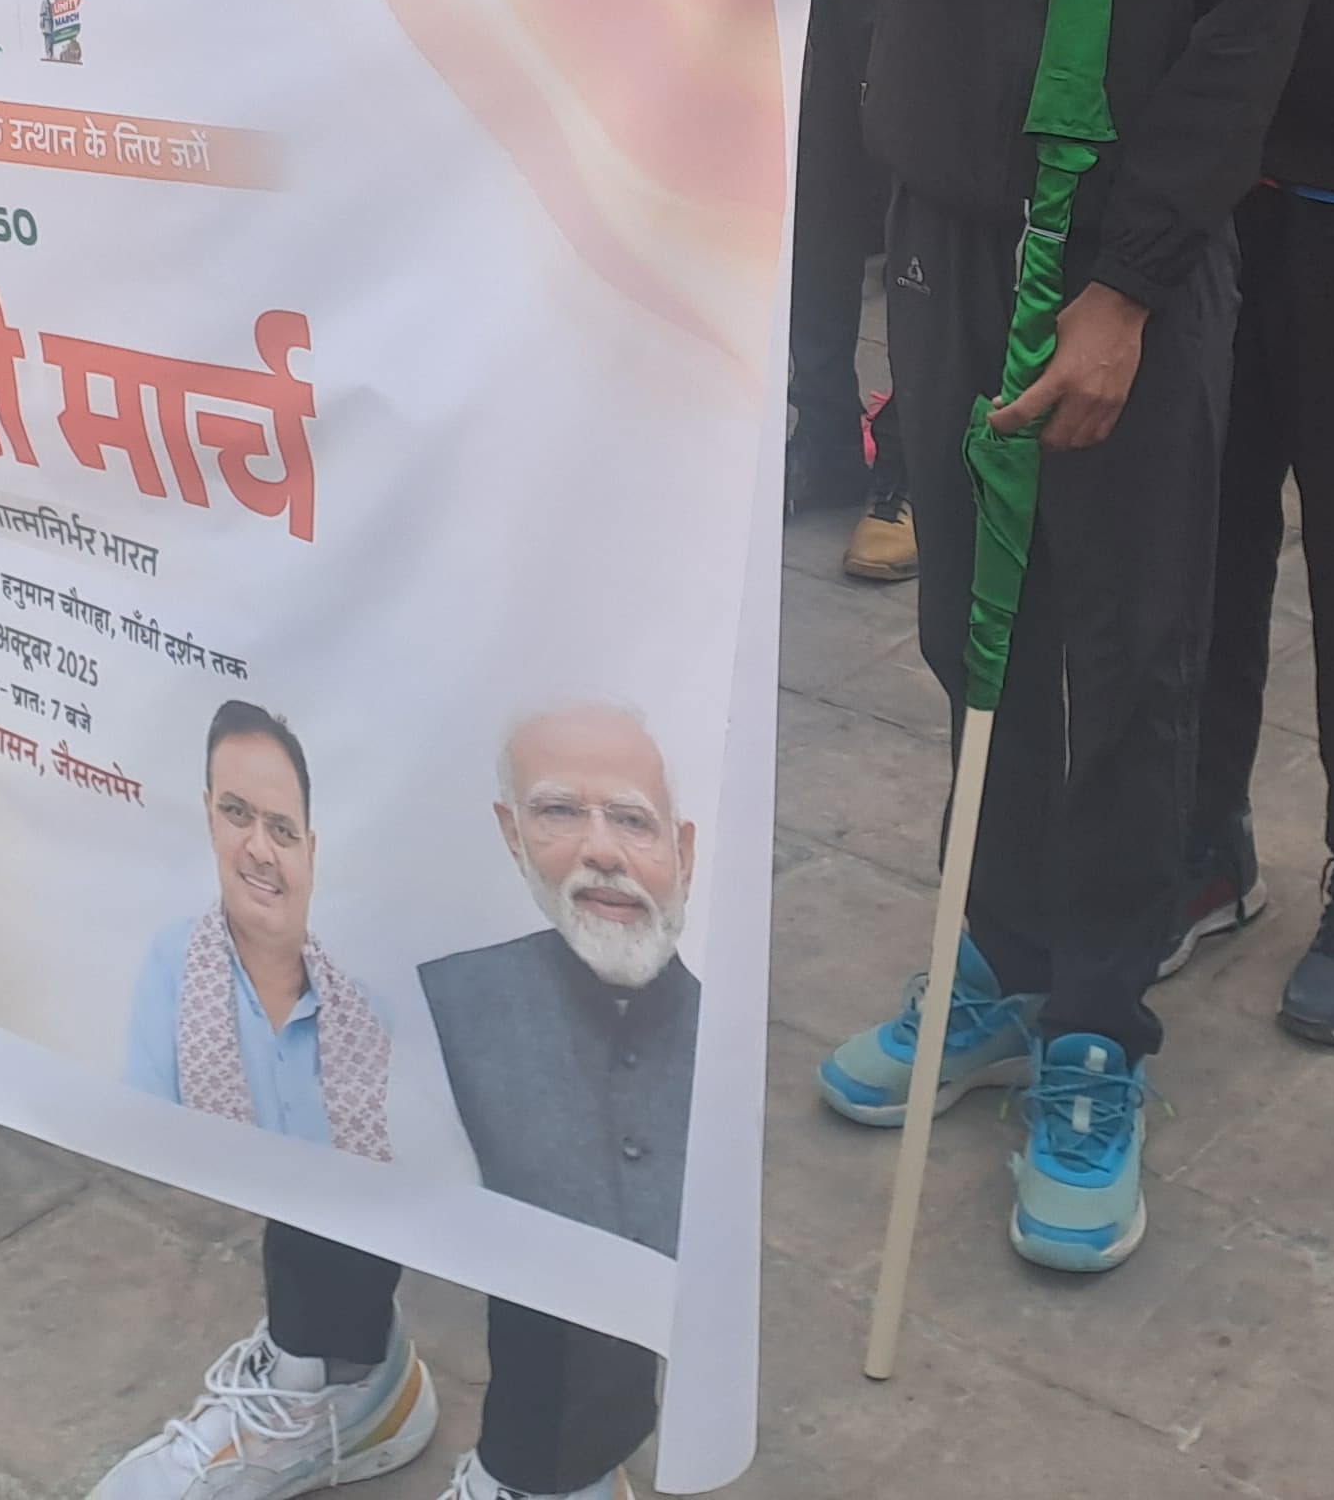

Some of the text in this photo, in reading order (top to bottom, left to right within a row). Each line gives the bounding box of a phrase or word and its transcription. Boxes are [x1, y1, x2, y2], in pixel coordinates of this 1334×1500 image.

[9, 118, 77, 157] उत्थान
[83, 116, 108, 158] के
[113, 121, 163, 166] लिए
[167, 129, 211, 172] जगें
[39, 308, 317, 544] मार्च
[100, 531, 160, 577] भारत
[1, 572, 55, 611] हनुमान
[58, 587, 117, 639] चौराहा,
[163, 631, 206, 670] दर्शन
[208, 649, 249, 681] तक
[56, 646, 99, 688] 2025
[51, 699, 61, 721] 7
[64, 702, 92, 734] बजे
[50, 740, 146, 808] जैसलमेर
